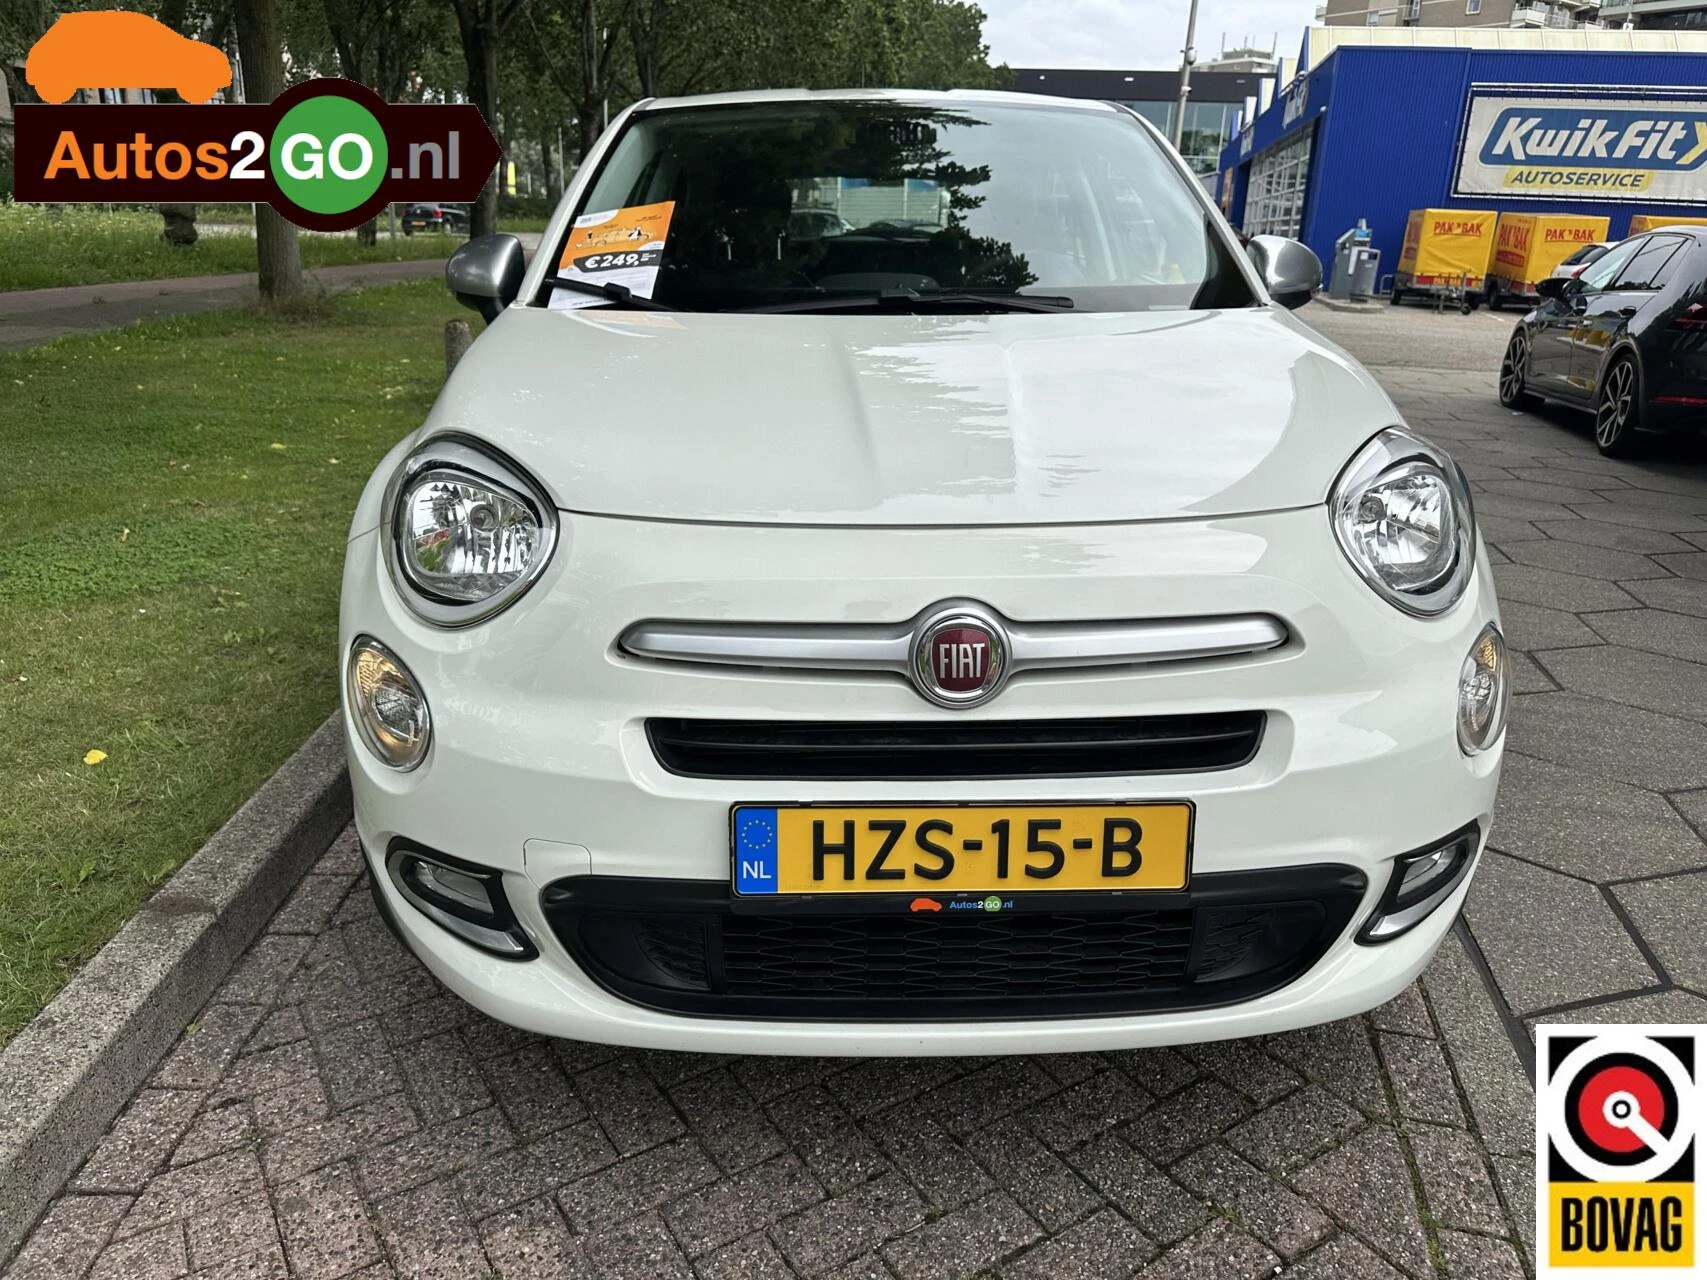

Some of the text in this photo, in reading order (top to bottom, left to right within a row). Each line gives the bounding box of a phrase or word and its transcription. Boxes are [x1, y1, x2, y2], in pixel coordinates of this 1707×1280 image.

[1511, 171, 1645, 188] AUTOSERVICE
[1434, 221, 1454, 234] PAK
[1461, 223, 1482, 235] BAK
[1544, 228, 1566, 240] PAK
[1572, 229, 1596, 242] BAK
[939, 643, 985, 679] FIAT
[812, 818, 1143, 881] HZS-15-B
[742, 861, 771, 880] NL
